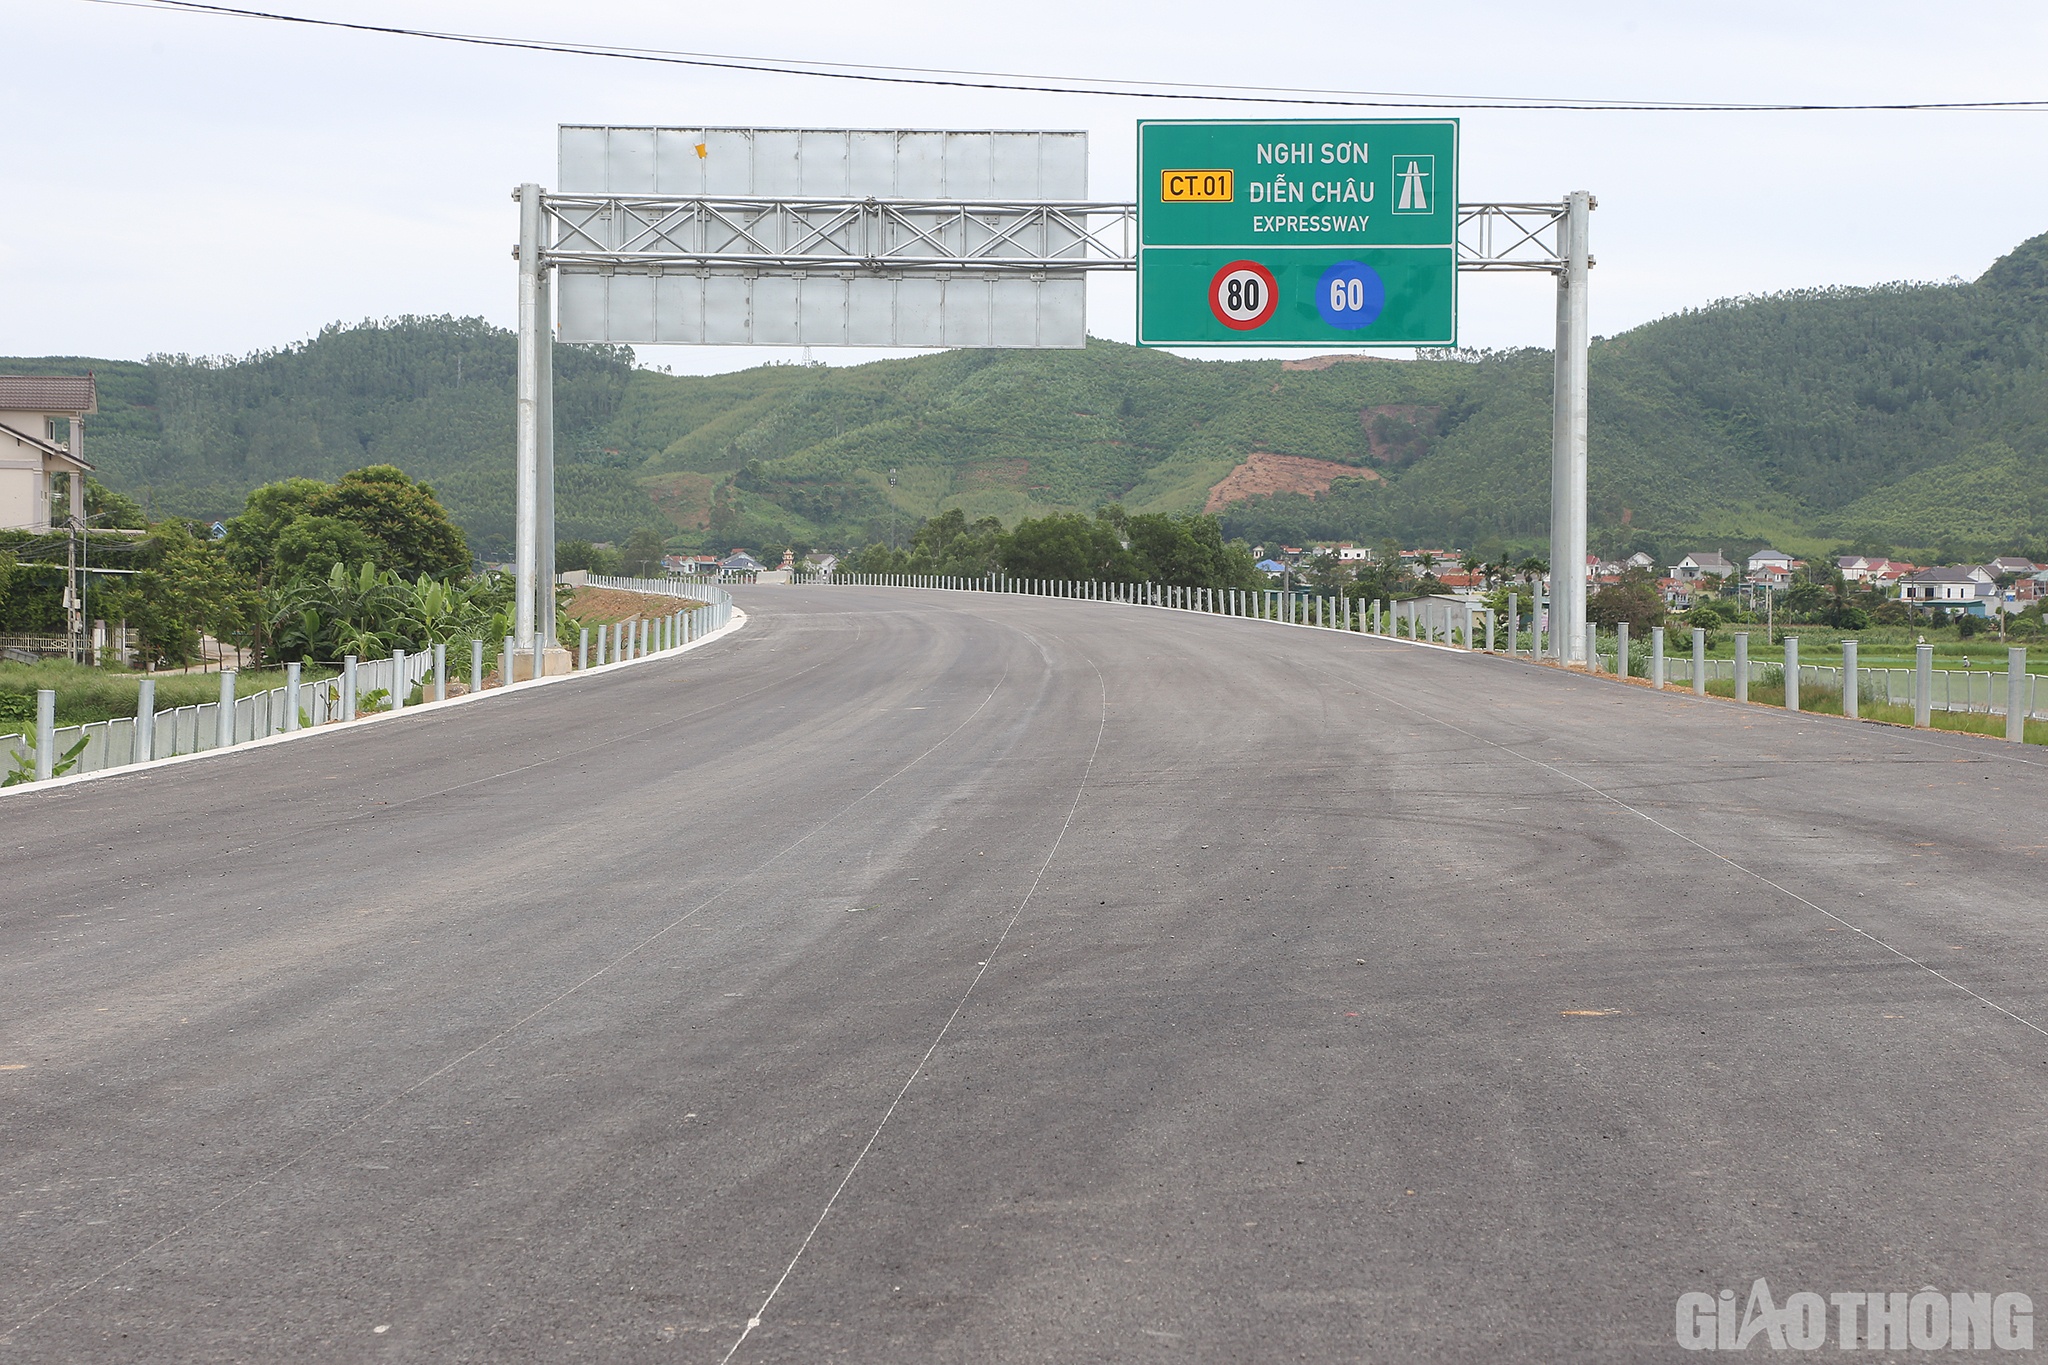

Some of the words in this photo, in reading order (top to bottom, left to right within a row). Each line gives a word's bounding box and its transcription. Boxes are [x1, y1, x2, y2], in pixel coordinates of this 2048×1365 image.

[1257, 143, 1313, 164] NGHI
[1320, 141, 1369, 164] SƠN
[1170, 176, 1226, 196] CT.01
[1250, 173, 1303, 203] DIỄN
[1311, 177, 1375, 203] CHÂU
[1253, 215, 1370, 232] EXPRESSWAY
[1227, 278, 1260, 311] 80
[1330, 278, 1364, 311] 60
